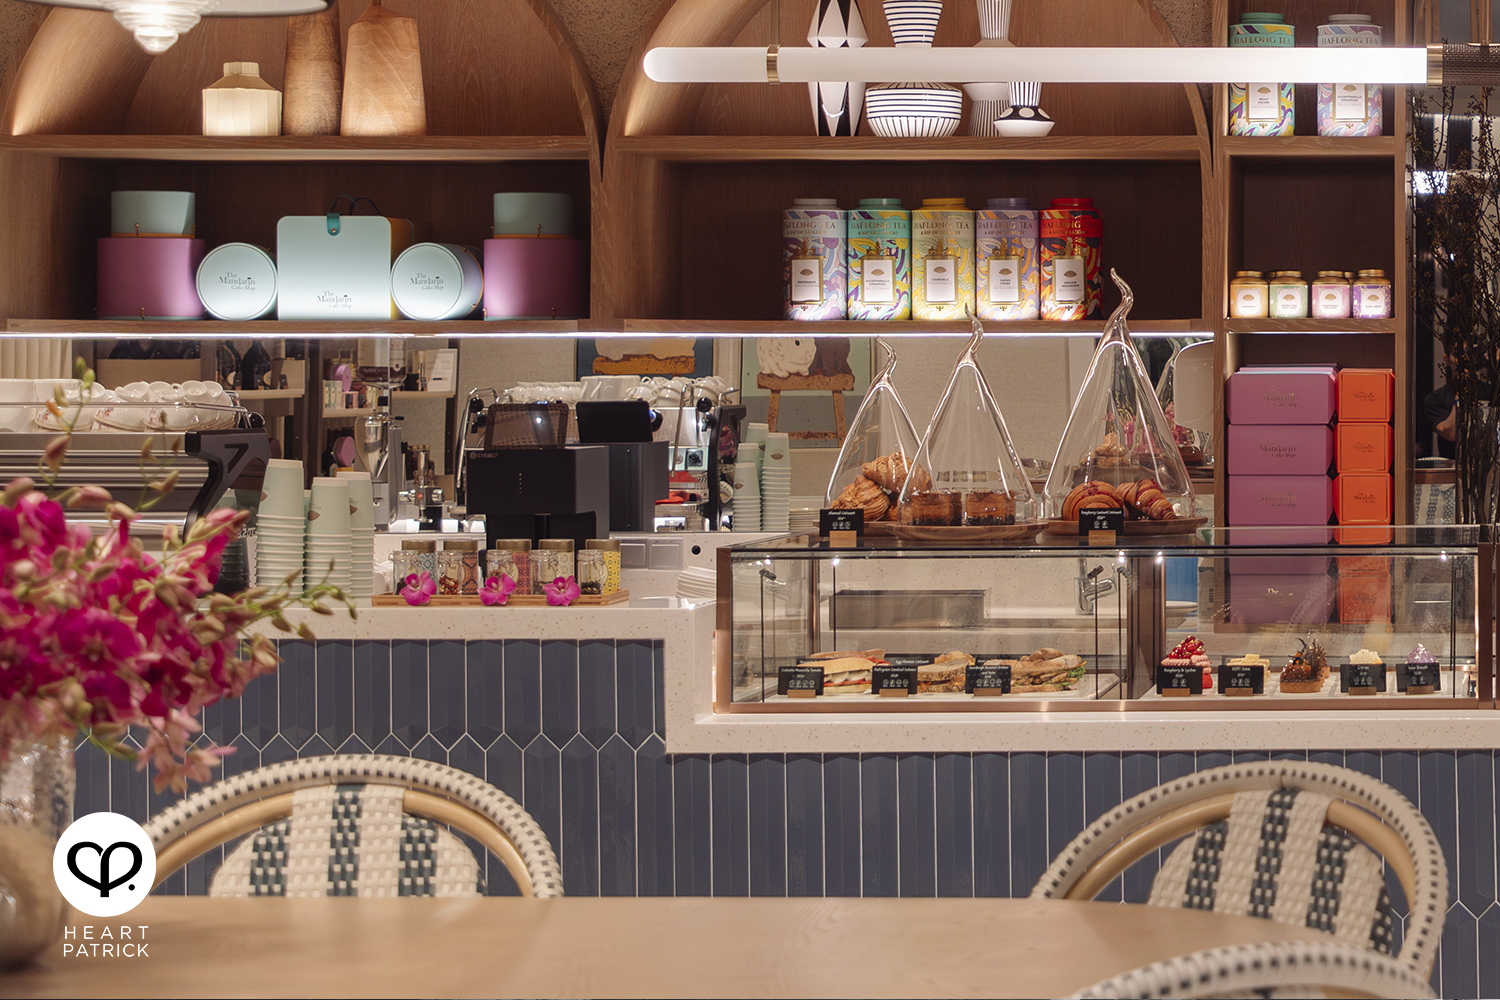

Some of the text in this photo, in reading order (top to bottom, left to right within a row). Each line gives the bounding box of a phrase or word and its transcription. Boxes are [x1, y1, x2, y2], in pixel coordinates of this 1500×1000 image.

[1234, 36, 1291, 45] HAFLONG TEA
[1321, 36, 1379, 45] HAFLONG TEA
[850, 221, 907, 230] HAFLONG TEA
[913, 221, 969, 230] HAFLONG TEA
[977, 221, 1033, 230] HAFLONG TEA
[219, 276, 256, 285] Mandarin
[410, 276, 444, 285] Mandarin
[317, 295, 352, 303] Mandarin
